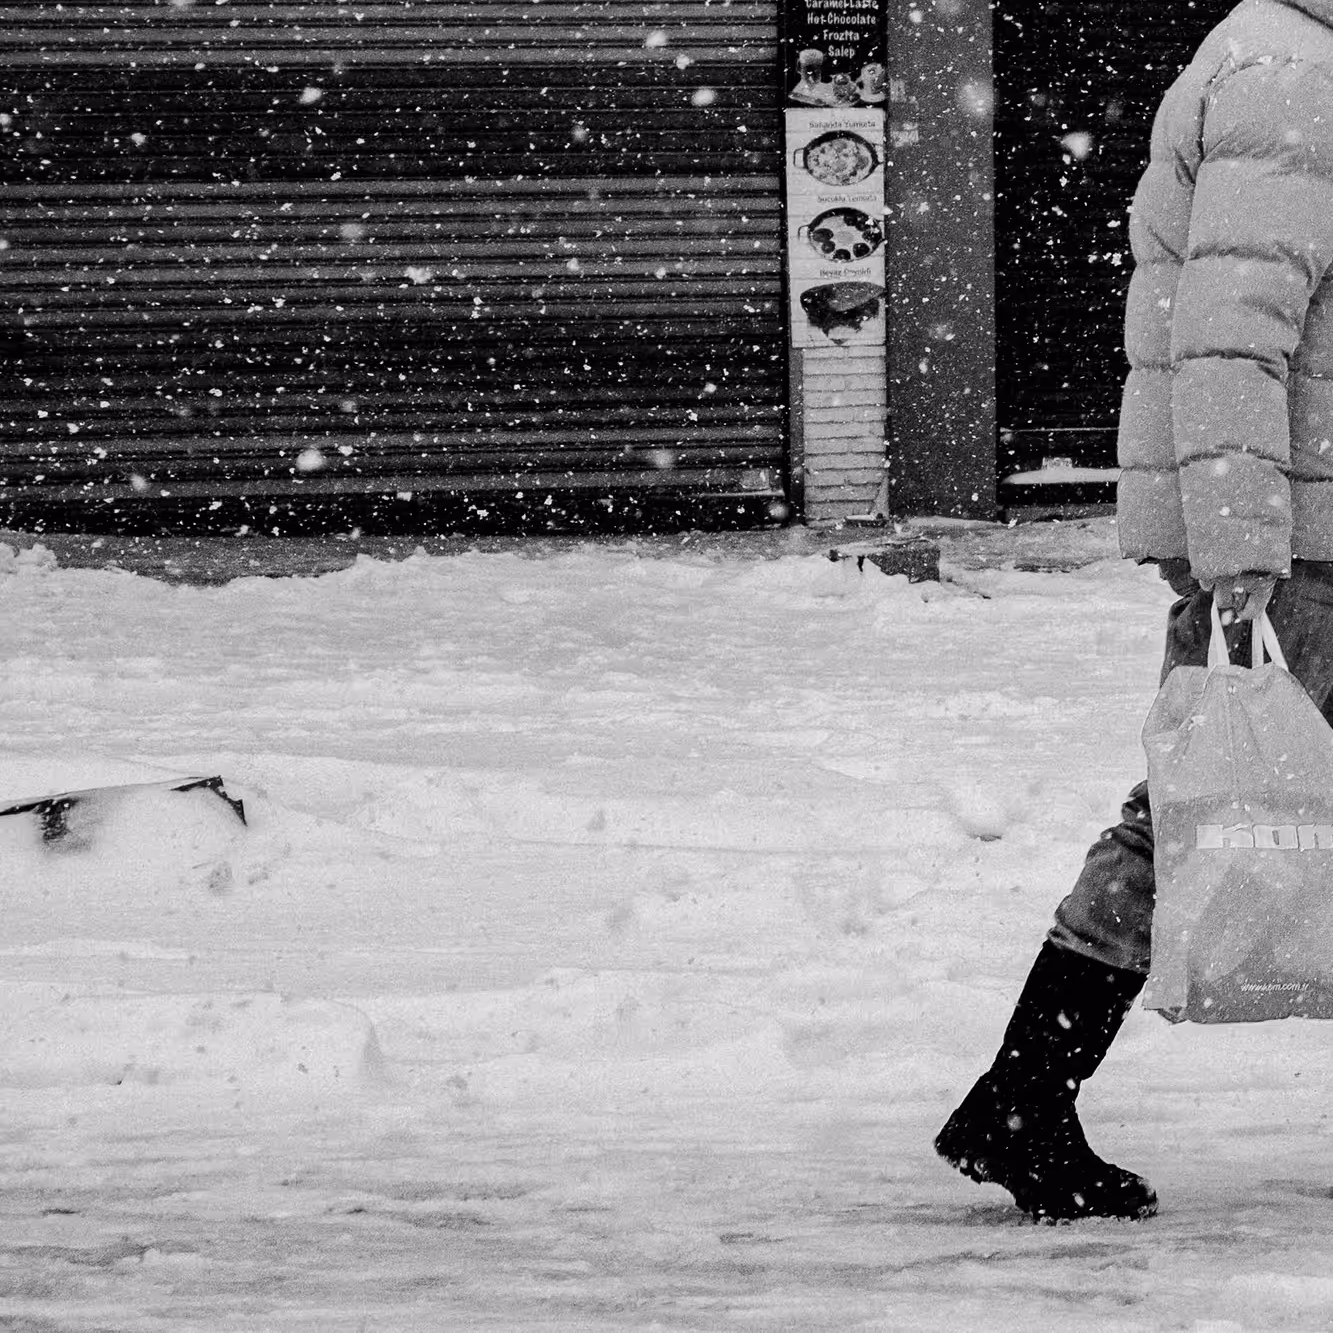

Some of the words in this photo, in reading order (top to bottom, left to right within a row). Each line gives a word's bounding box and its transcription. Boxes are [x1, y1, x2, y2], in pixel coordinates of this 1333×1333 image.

[807, 12, 825, 24] Hot
[827, 12, 877, 24] Chocolate
[828, 45, 855, 59] Salep
